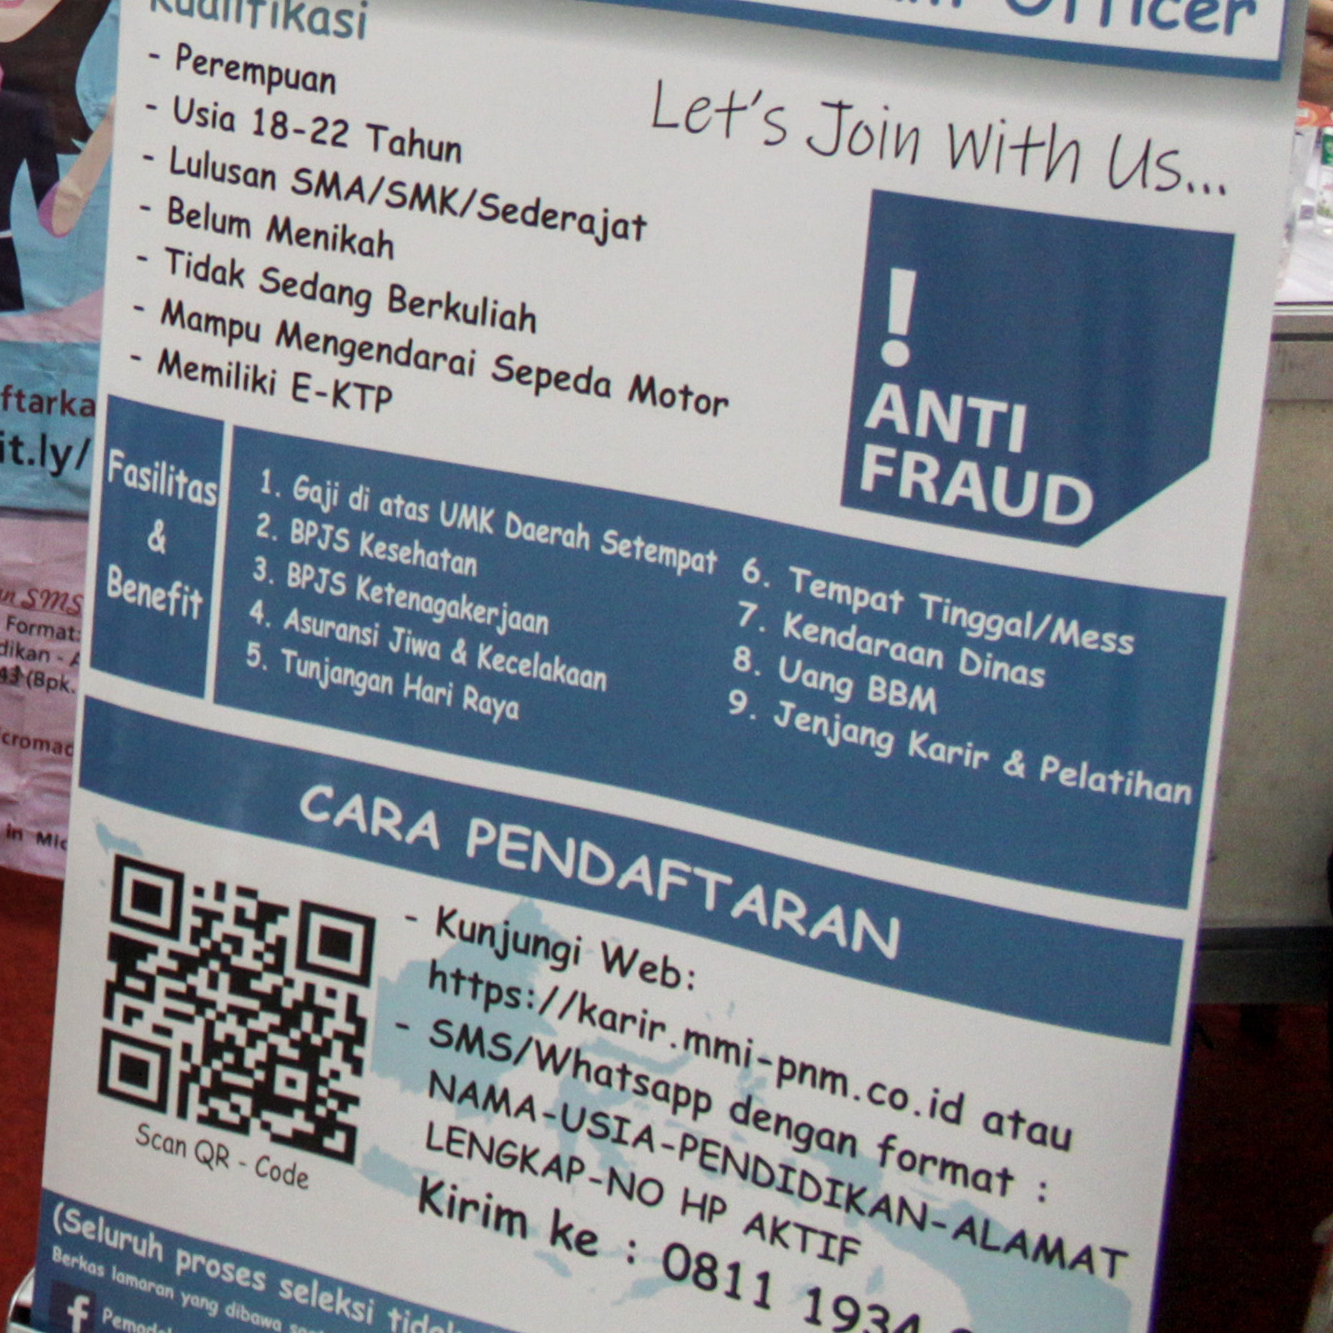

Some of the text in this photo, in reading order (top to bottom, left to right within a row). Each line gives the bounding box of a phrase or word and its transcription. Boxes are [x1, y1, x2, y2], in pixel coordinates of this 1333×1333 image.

[175, 43, 336, 95] Perempuan
[173, 96, 463, 165] Usia 18-22 Tahun
[651, 79, 1226, 196] Let's Join With Us...
[167, 196, 395, 261] Belum Menikah
[169, 146, 648, 246] Lulusan SMA/SMK/Sederajat
[165, 247, 537, 335] Tidak Sedang Berkuliah
[157, 348, 393, 415] Memiliki E-KTP
[160, 299, 729, 417] Mampu Mengendarai Sepeda Motor
[864, 383, 1026, 453] ANTI
[107, 448, 218, 506] Fasilitas
[860, 443, 1094, 527] FRAUD
[291, 519, 477, 577] BPJS Kesehatan
[293, 476, 718, 576] Gaji atas UMK Daerah Setempat
[106, 565, 203, 620] Benefit
[287, 563, 550, 636] BPJS Ketenagakerjaan
[789, 566, 1135, 656] Tempat Tinggal/Mess
[281, 649, 520, 725] Tunjangan Hari Raya
[283, 608, 607, 693] Asuransi Jiwa Kecelakaan
[778, 655, 938, 715] Uang BBM
[783, 611, 1047, 688] Kendaraan Dinas
[774, 701, 1192, 805] Jenjang Karir Pelatihan
[299, 784, 901, 961] CARA PENDAFTARAN
[435, 906, 697, 993] Kunjungi Web:
[427, 959, 1073, 1152] https://karir.mmi-pnm.co.id atau
[429, 1017, 1015, 1198] SMS/Whatsapp dengan format
[135, 1123, 310, 1192] Scan Code
[426, 1120, 863, 1267] LENGKAP-NO HP AKTIF
[428, 1070, 1129, 1281] NAMA-USIA-PENDIDIKAN-ALAMAT
[53, 1202, 376, 1326] (Seluruh proses seleksi
[418, 1177, 772, 1311] Kirim ke 0811
[52, 1246, 282, 1332] Berkas lamaran yang dibawa
